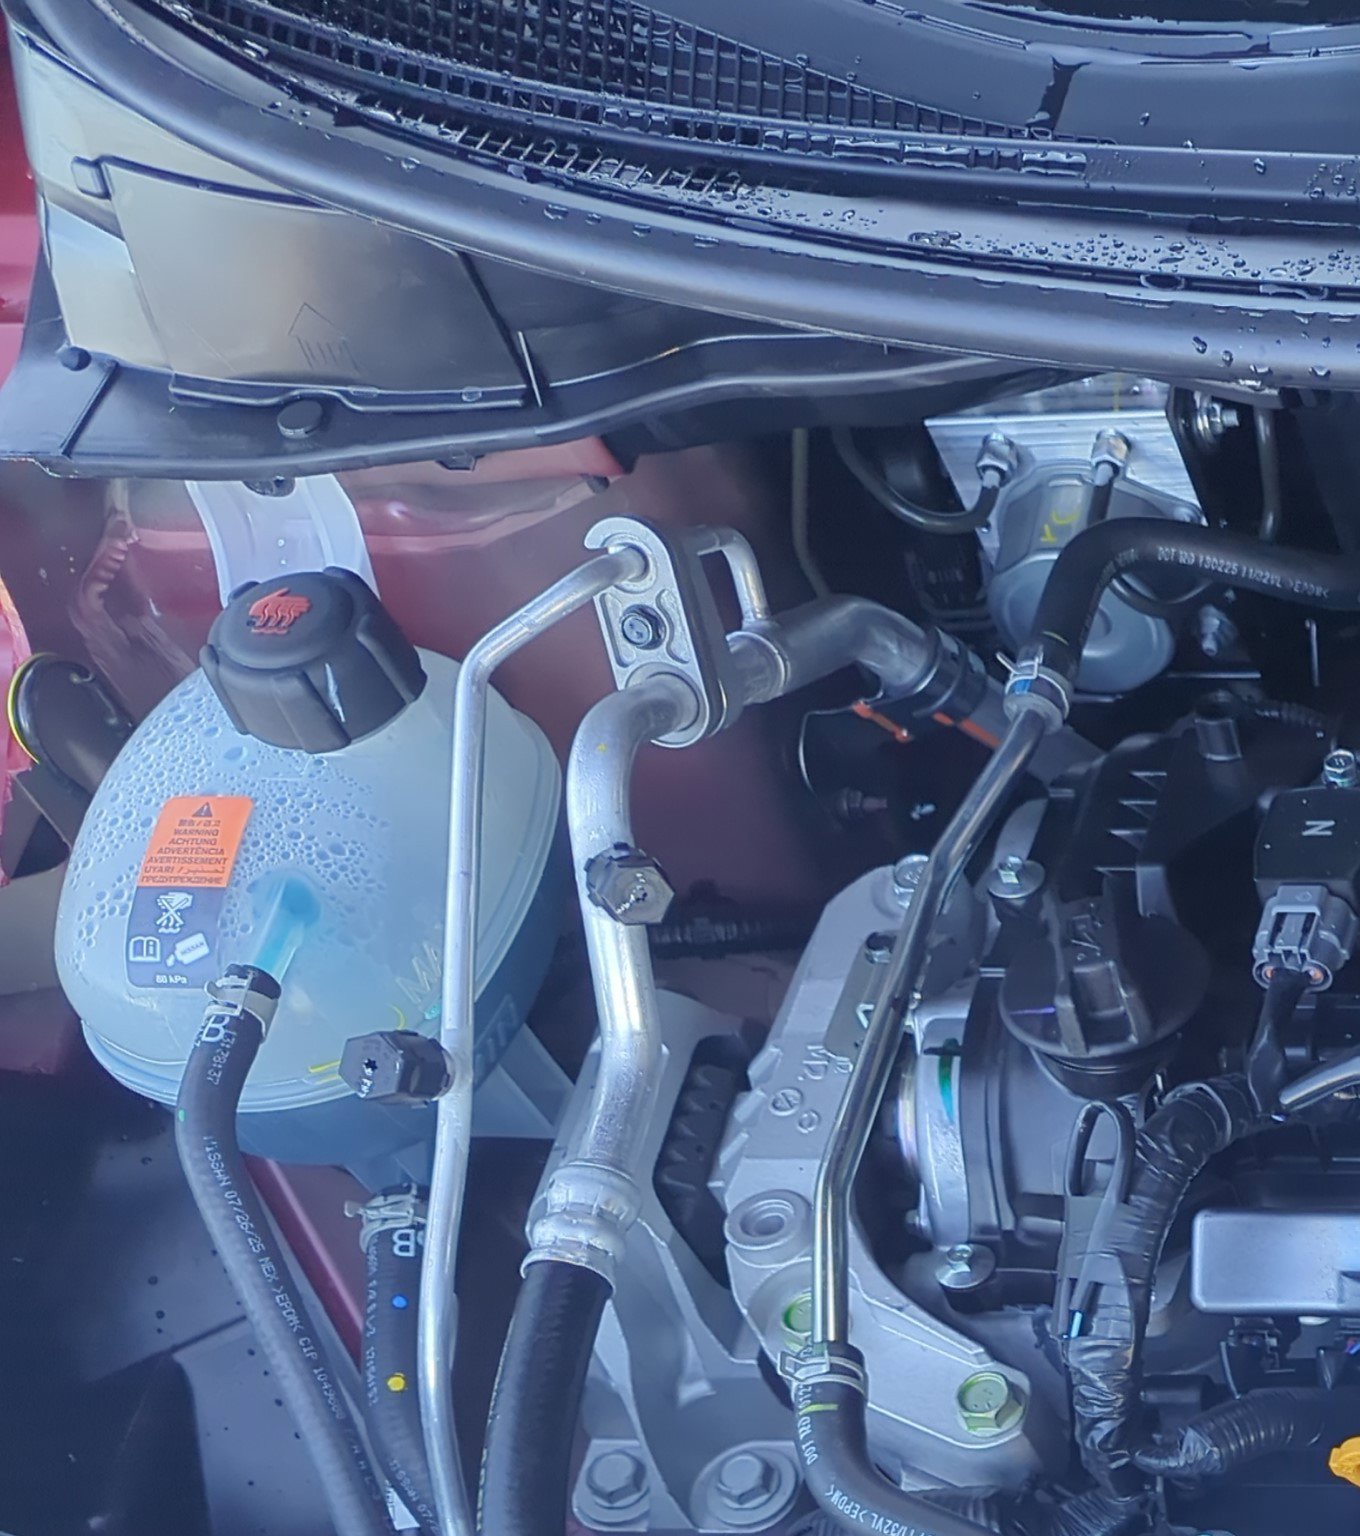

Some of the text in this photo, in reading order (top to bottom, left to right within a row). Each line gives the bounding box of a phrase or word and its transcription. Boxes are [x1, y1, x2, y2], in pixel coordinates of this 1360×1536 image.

[147, 856, 227, 865] AVERTISSEMENT
[801, 1441, 819, 1466] DOT
[824, 1484, 866, 1524] >EPDM<
